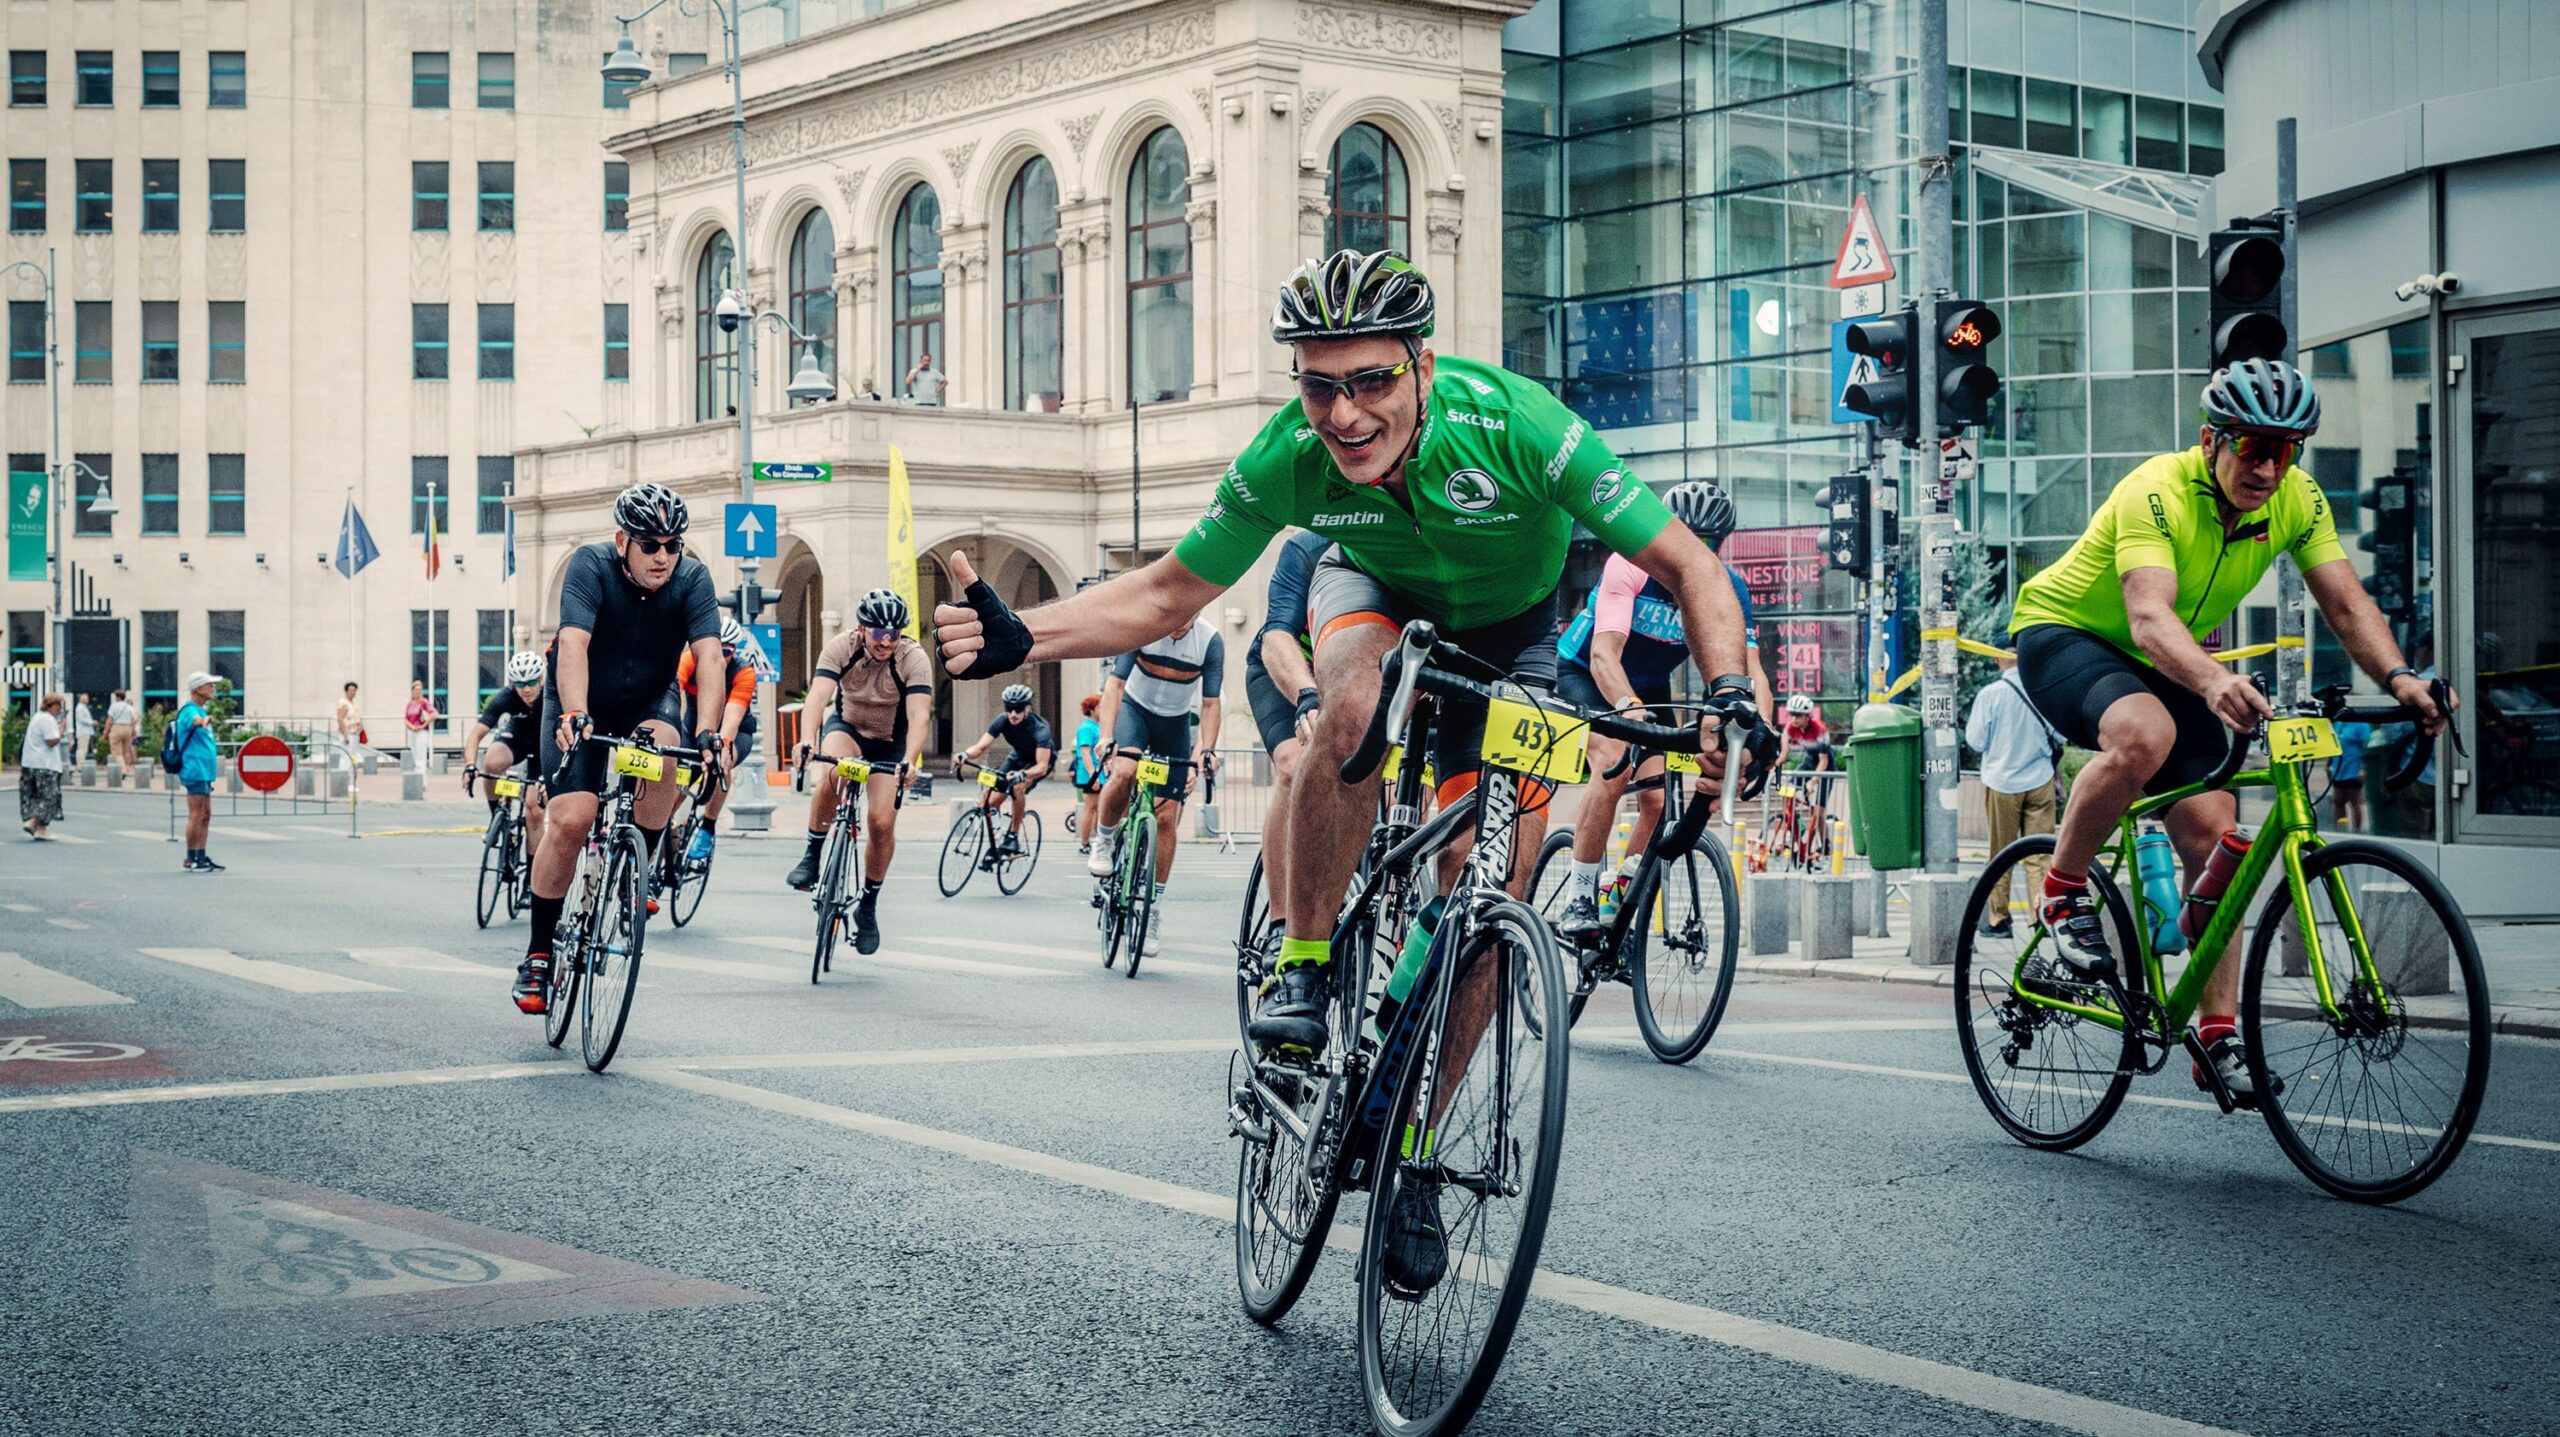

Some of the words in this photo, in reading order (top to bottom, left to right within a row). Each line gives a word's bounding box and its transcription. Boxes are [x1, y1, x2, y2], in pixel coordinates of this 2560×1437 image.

[1446, 408, 1506, 432] ŠKODA
[1227, 459, 1260, 503] ntini
[1603, 486, 1642, 525] ŠKODA
[1311, 511, 1385, 527] Santini
[1453, 512, 1520, 526] ŠKODA
[1737, 564, 1820, 585] NESTONE
[1751, 593, 1767, 605] NE
[1770, 591, 1802, 605] SHOP
[1638, 603, 1683, 628] L'ETA
[1777, 644, 1788, 665] LA
[1795, 647, 1817, 665] 41
[1777, 669, 1788, 692] DE
[1791, 671, 1821, 692] LEI
[1929, 697, 1951, 711] BNE
[2287, 725, 2318, 746] 214
[629, 753, 649, 769] 236
[1144, 765, 1160, 777] 446
[1416, 1030, 1437, 1120] GIANT
